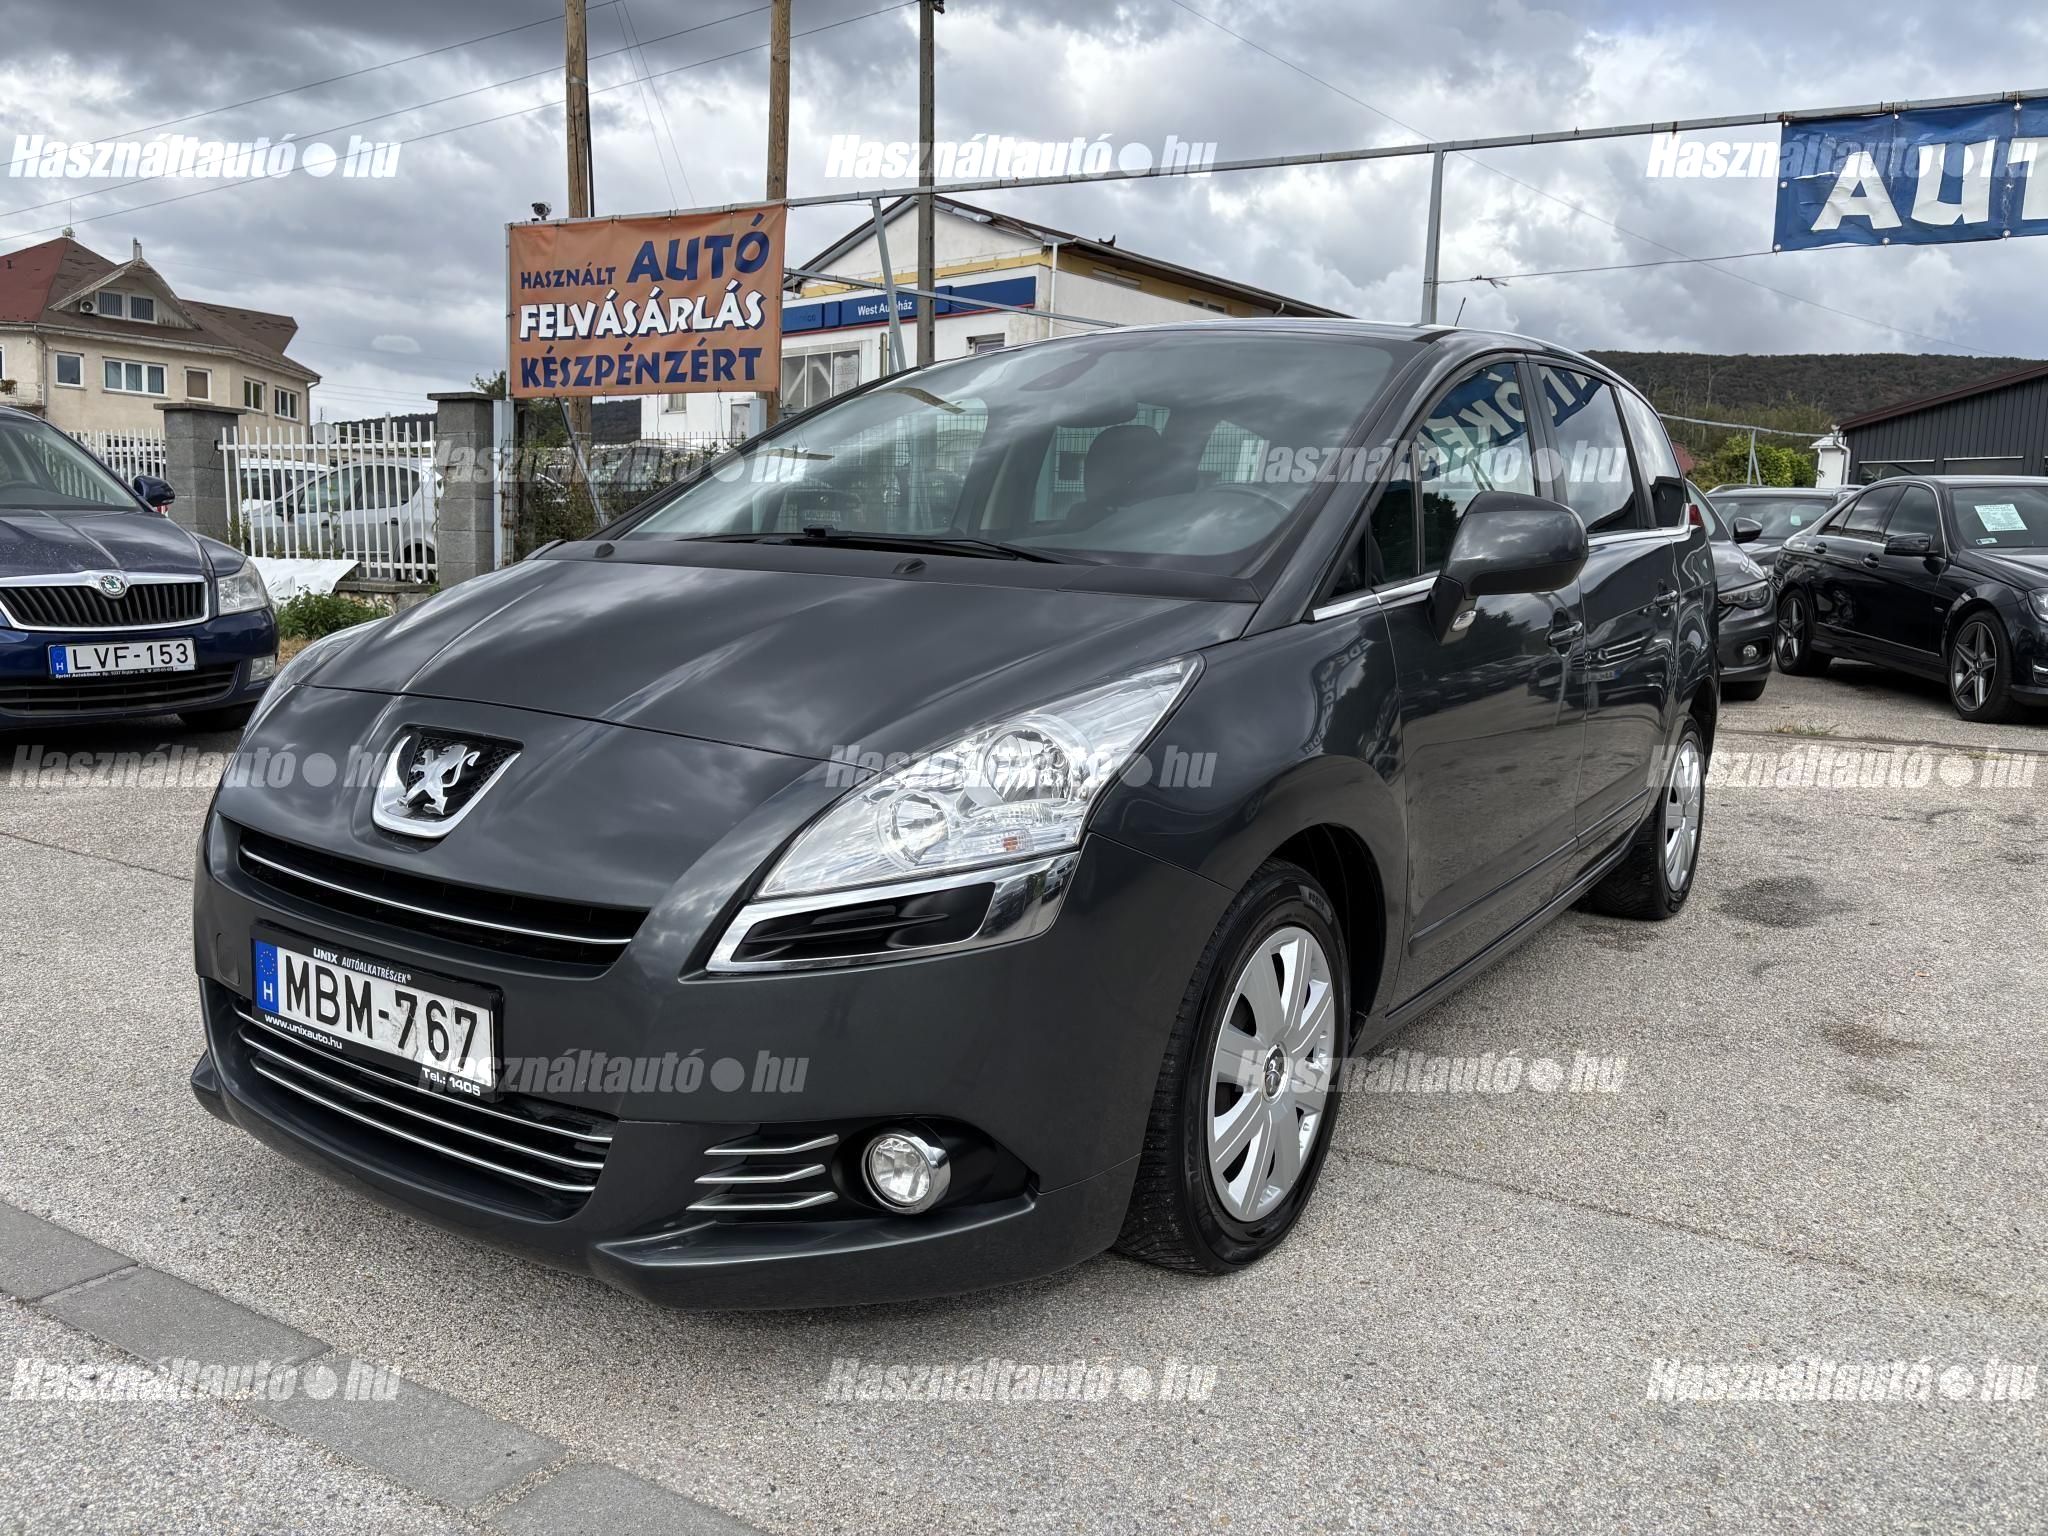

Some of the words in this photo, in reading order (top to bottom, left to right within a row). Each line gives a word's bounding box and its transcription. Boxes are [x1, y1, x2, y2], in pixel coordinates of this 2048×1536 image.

[520, 262, 617, 290] HASZNÁLT
[626, 213, 770, 284] AUTÓ
[519, 278, 768, 342] FELVÁSÁRLÁS
[857, 303, 878, 317] West
[879, 299, 913, 314] Auház
[520, 337, 763, 389] KÉSZPÉNZÉRT
[56, 662, 64, 671] H
[72, 643, 189, 671] LVF-153
[312, 947, 338, 965] UNIX
[263, 980, 274, 1003] H
[285, 954, 478, 1072] MBM-767
[264, 1013, 343, 1050] www.unixauto.hu
[421, 1067, 447, 1086] Tel.:
[448, 1076, 481, 1097] 1405
